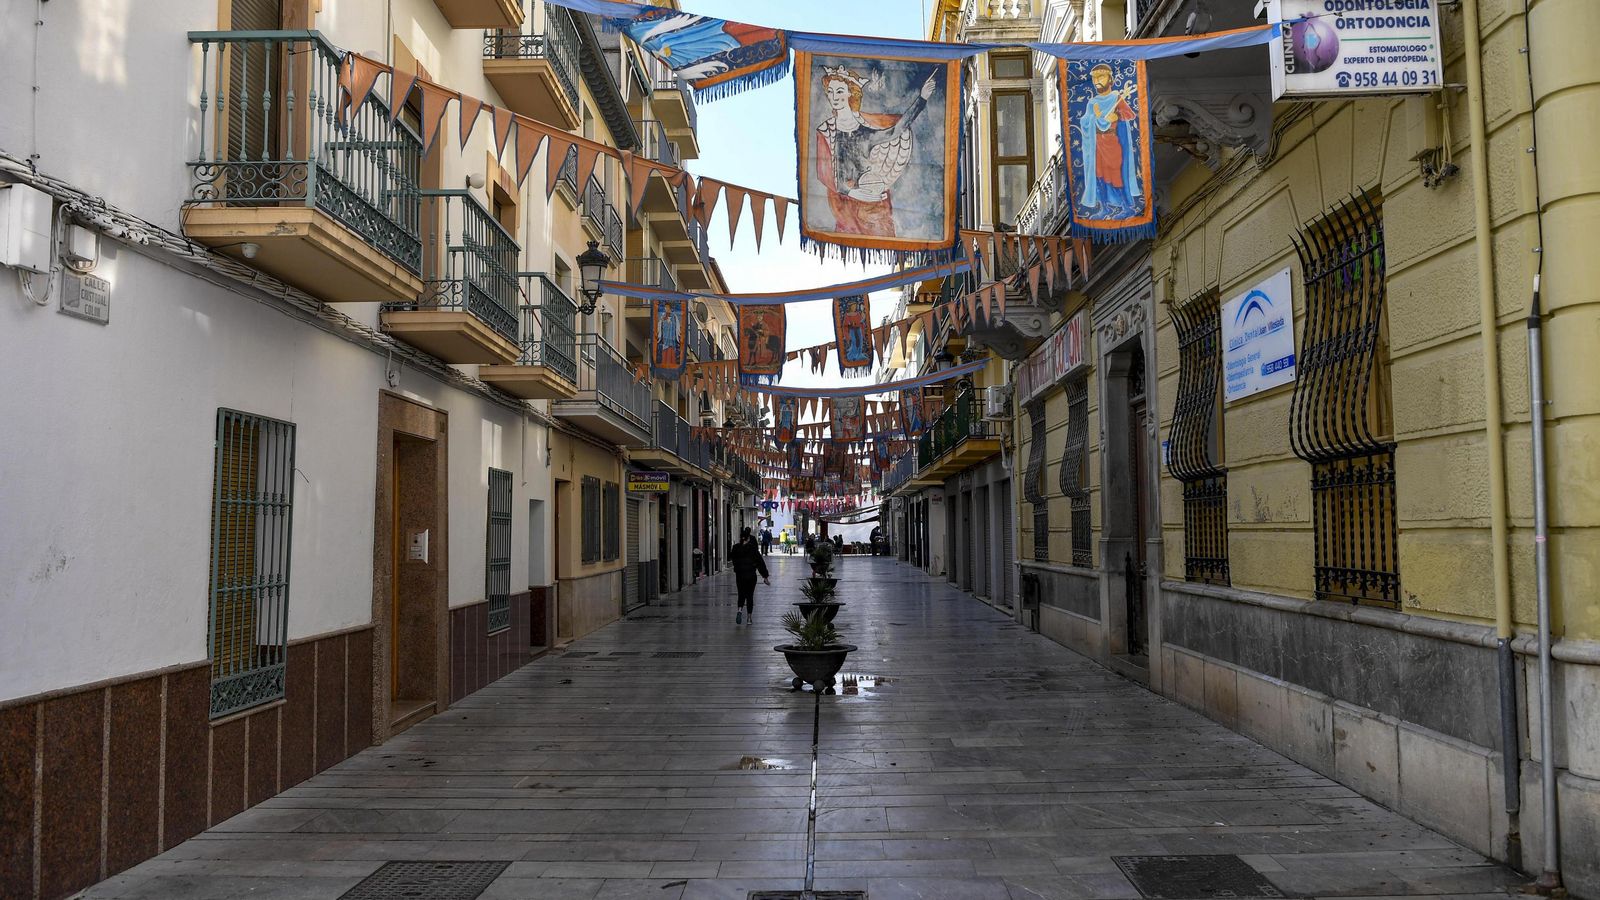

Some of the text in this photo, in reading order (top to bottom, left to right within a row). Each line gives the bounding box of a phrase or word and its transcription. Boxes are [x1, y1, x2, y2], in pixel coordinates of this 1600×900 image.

[1335, 16, 1431, 29] ORTODONCIA
[1282, 22, 1296, 74] CLINICA
[1369, 45, 1428, 53] ESTOMATOLOGO
[1344, 56, 1375, 64] EXPERTO
[1355, 70, 1437, 87] 958 44 09 31
[84, 277, 105, 291] CALLE
